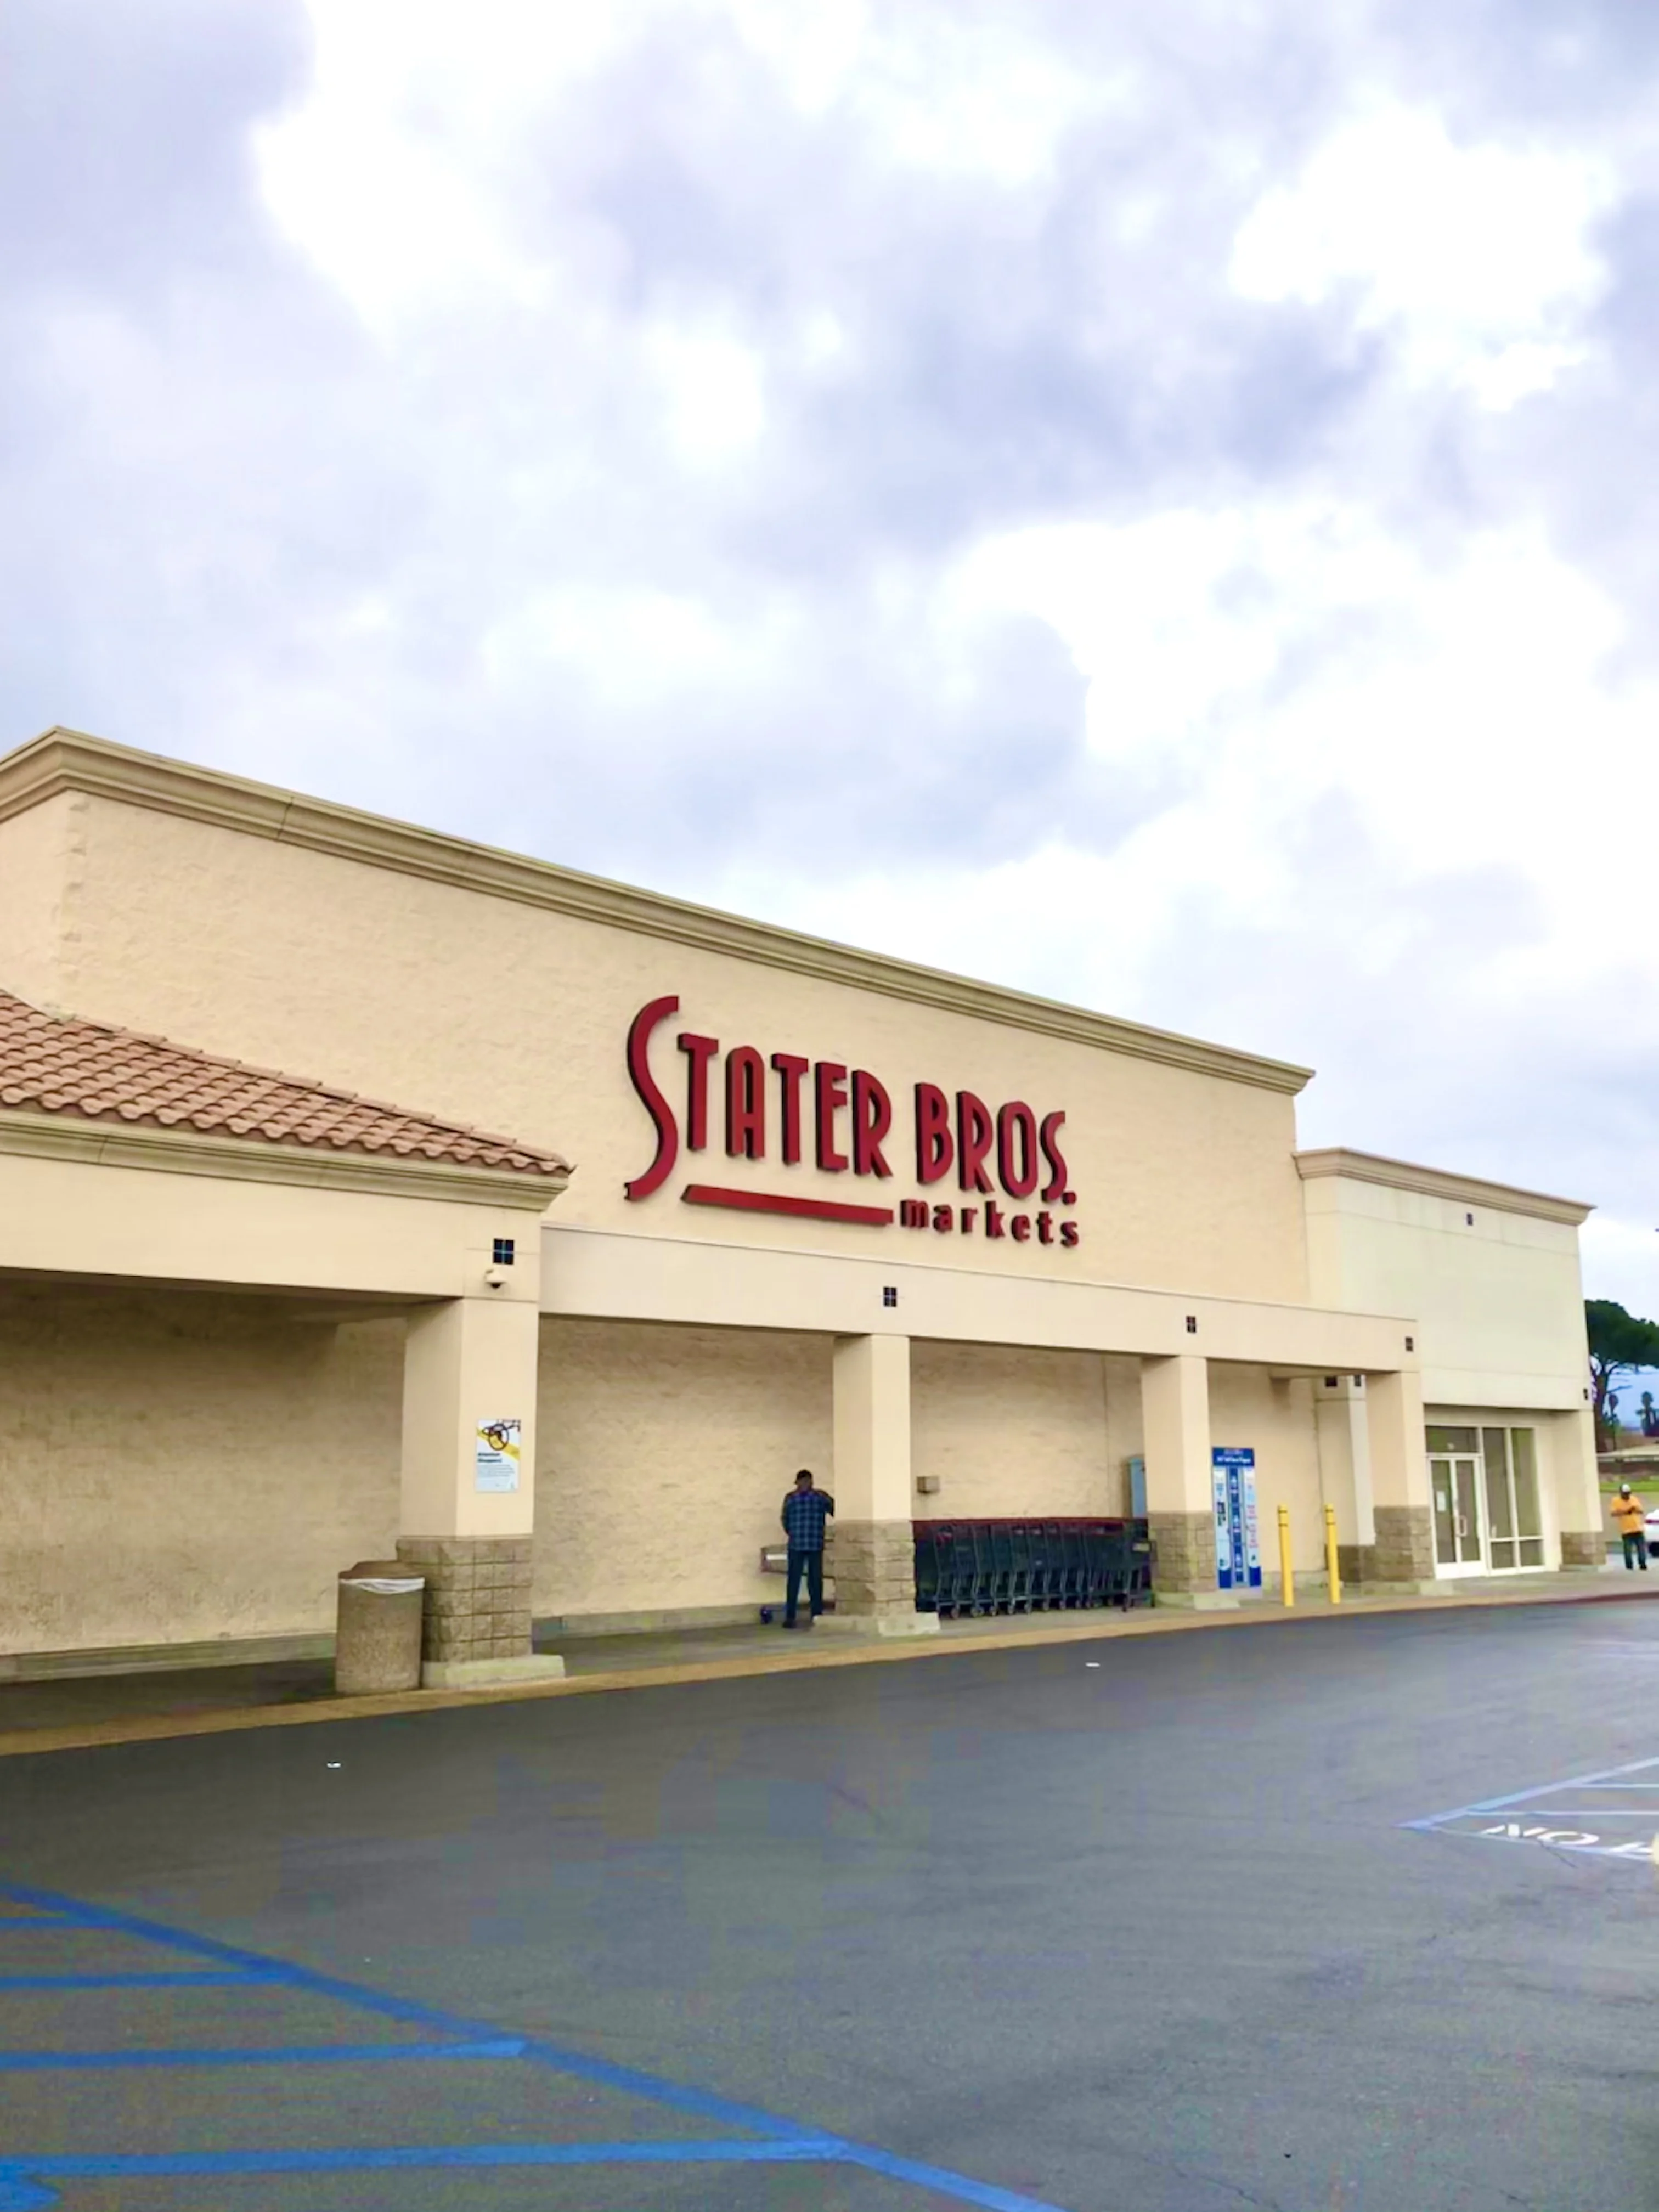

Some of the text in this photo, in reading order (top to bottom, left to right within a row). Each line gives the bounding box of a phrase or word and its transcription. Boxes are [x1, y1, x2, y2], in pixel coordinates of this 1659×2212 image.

[624, 995, 1077, 1205] STATER BROS.
[900, 1199, 1079, 1247] markets
